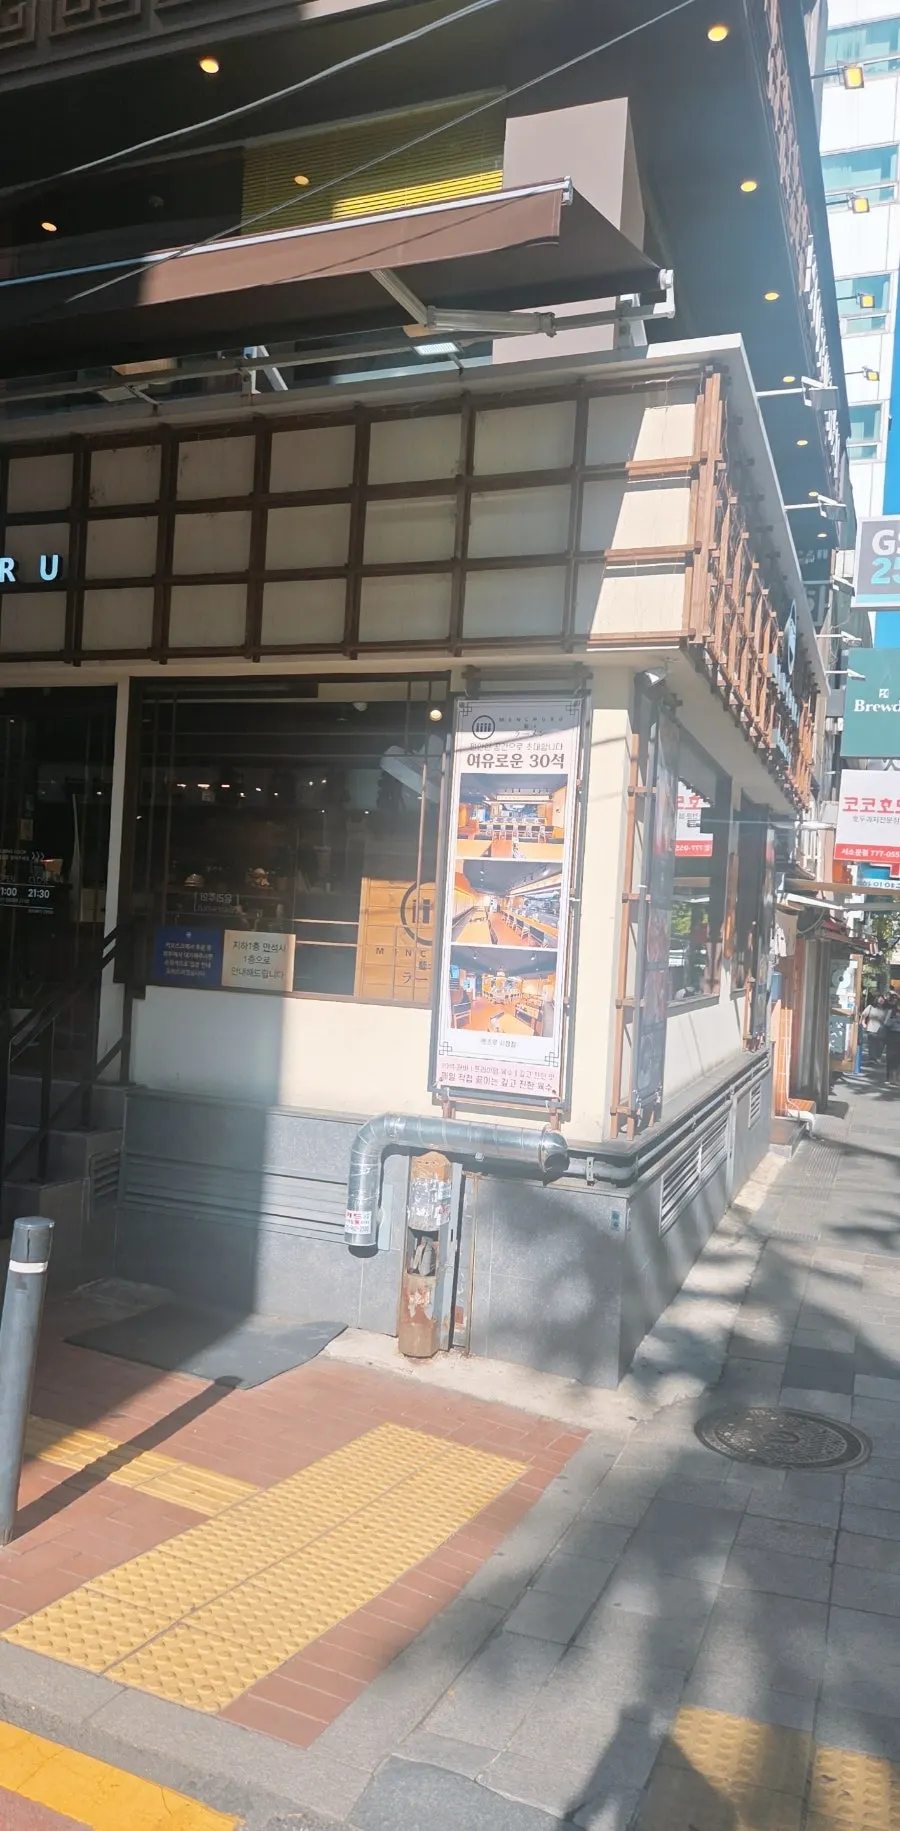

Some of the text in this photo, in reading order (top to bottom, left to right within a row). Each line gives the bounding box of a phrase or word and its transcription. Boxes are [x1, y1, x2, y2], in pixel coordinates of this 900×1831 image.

[467, 753, 564, 769] 여유로운 30석
[28, 888, 50, 898] 21:30
[232, 940, 260, 951] 지하1층
[243, 954, 272, 965] 1층으로
[231, 966, 286, 981] 안내해드립니다
[458, 1072, 473, 1084] 직접
[519, 1080, 535, 1090] 진한
